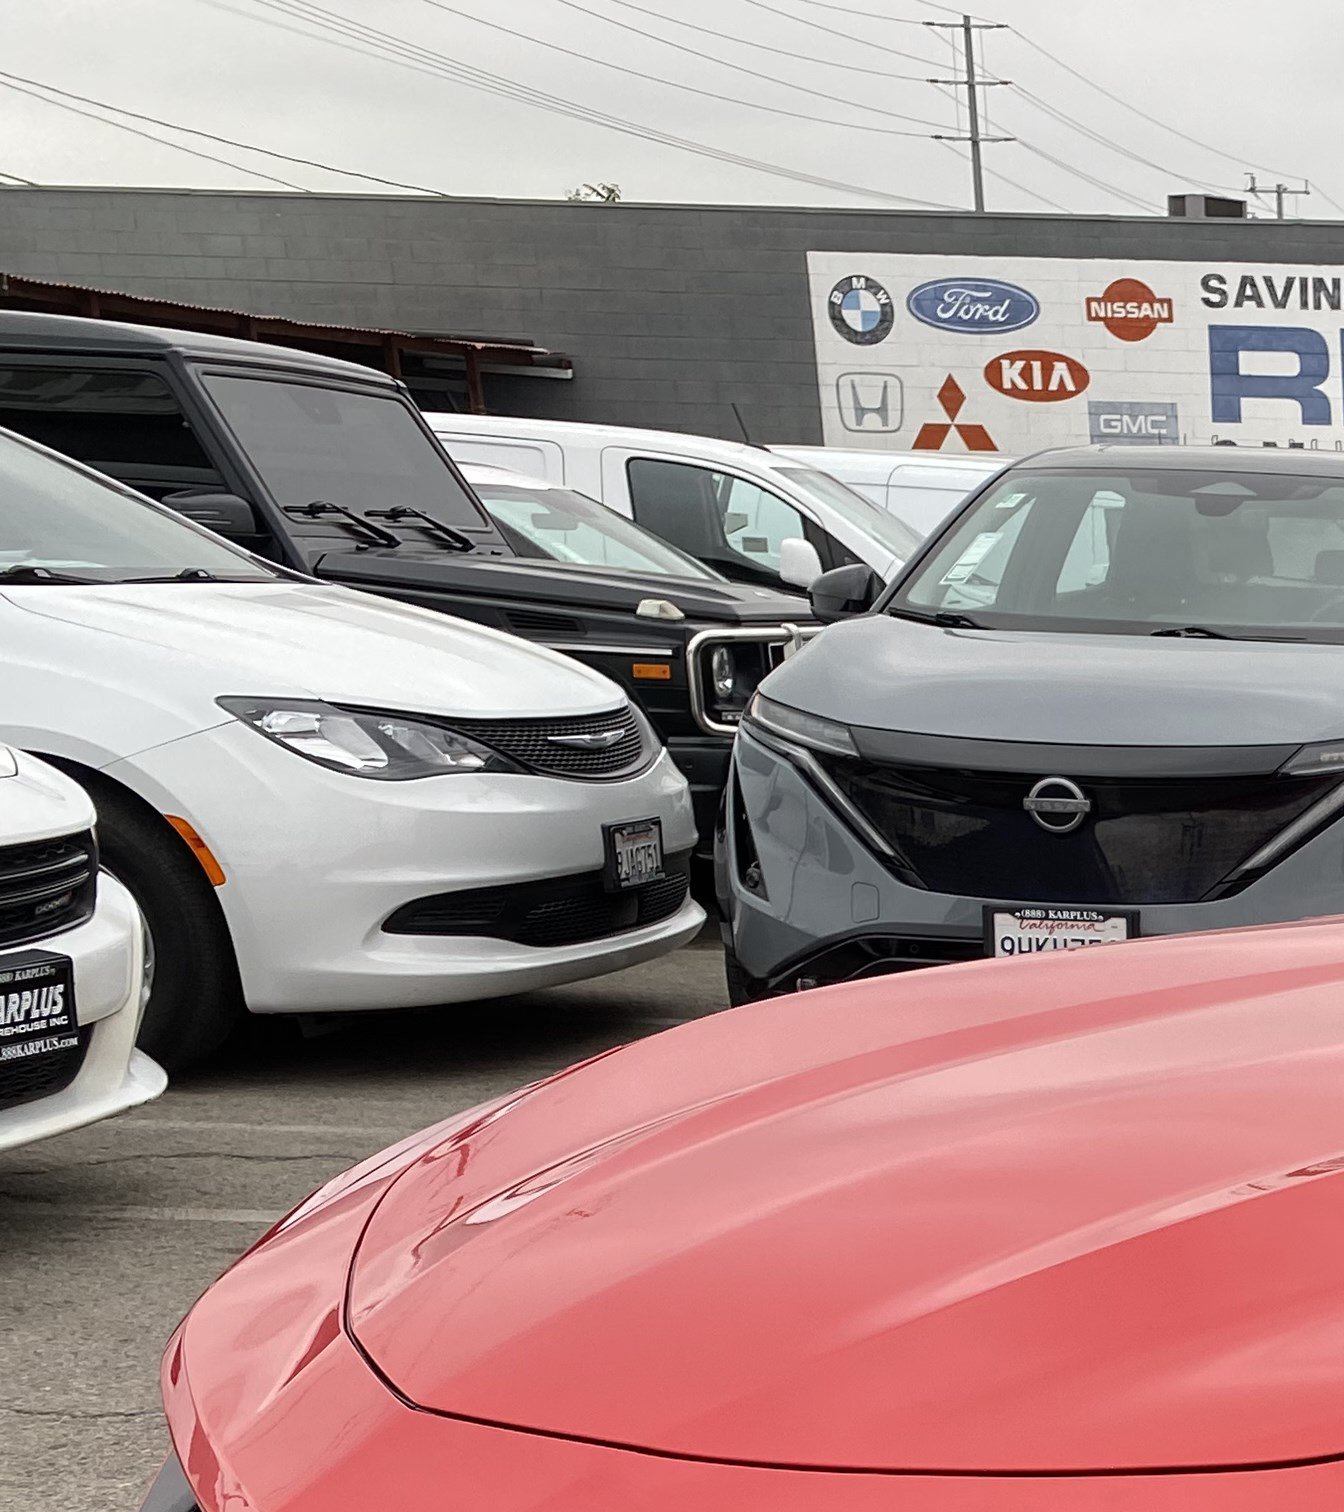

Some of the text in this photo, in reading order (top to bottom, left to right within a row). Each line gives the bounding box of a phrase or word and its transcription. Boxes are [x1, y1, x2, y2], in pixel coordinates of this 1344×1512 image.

[937, 288, 1010, 323] Ford
[1090, 300, 1170, 319] NISSAN
[999, 358, 1078, 392] KIA
[1099, 414, 1167, 435] GMC
[1021, 909, 1098, 920] (888) KARPLUS
[1019, 919, 1106, 936] California
[49, 1016, 68, 1027] INC
